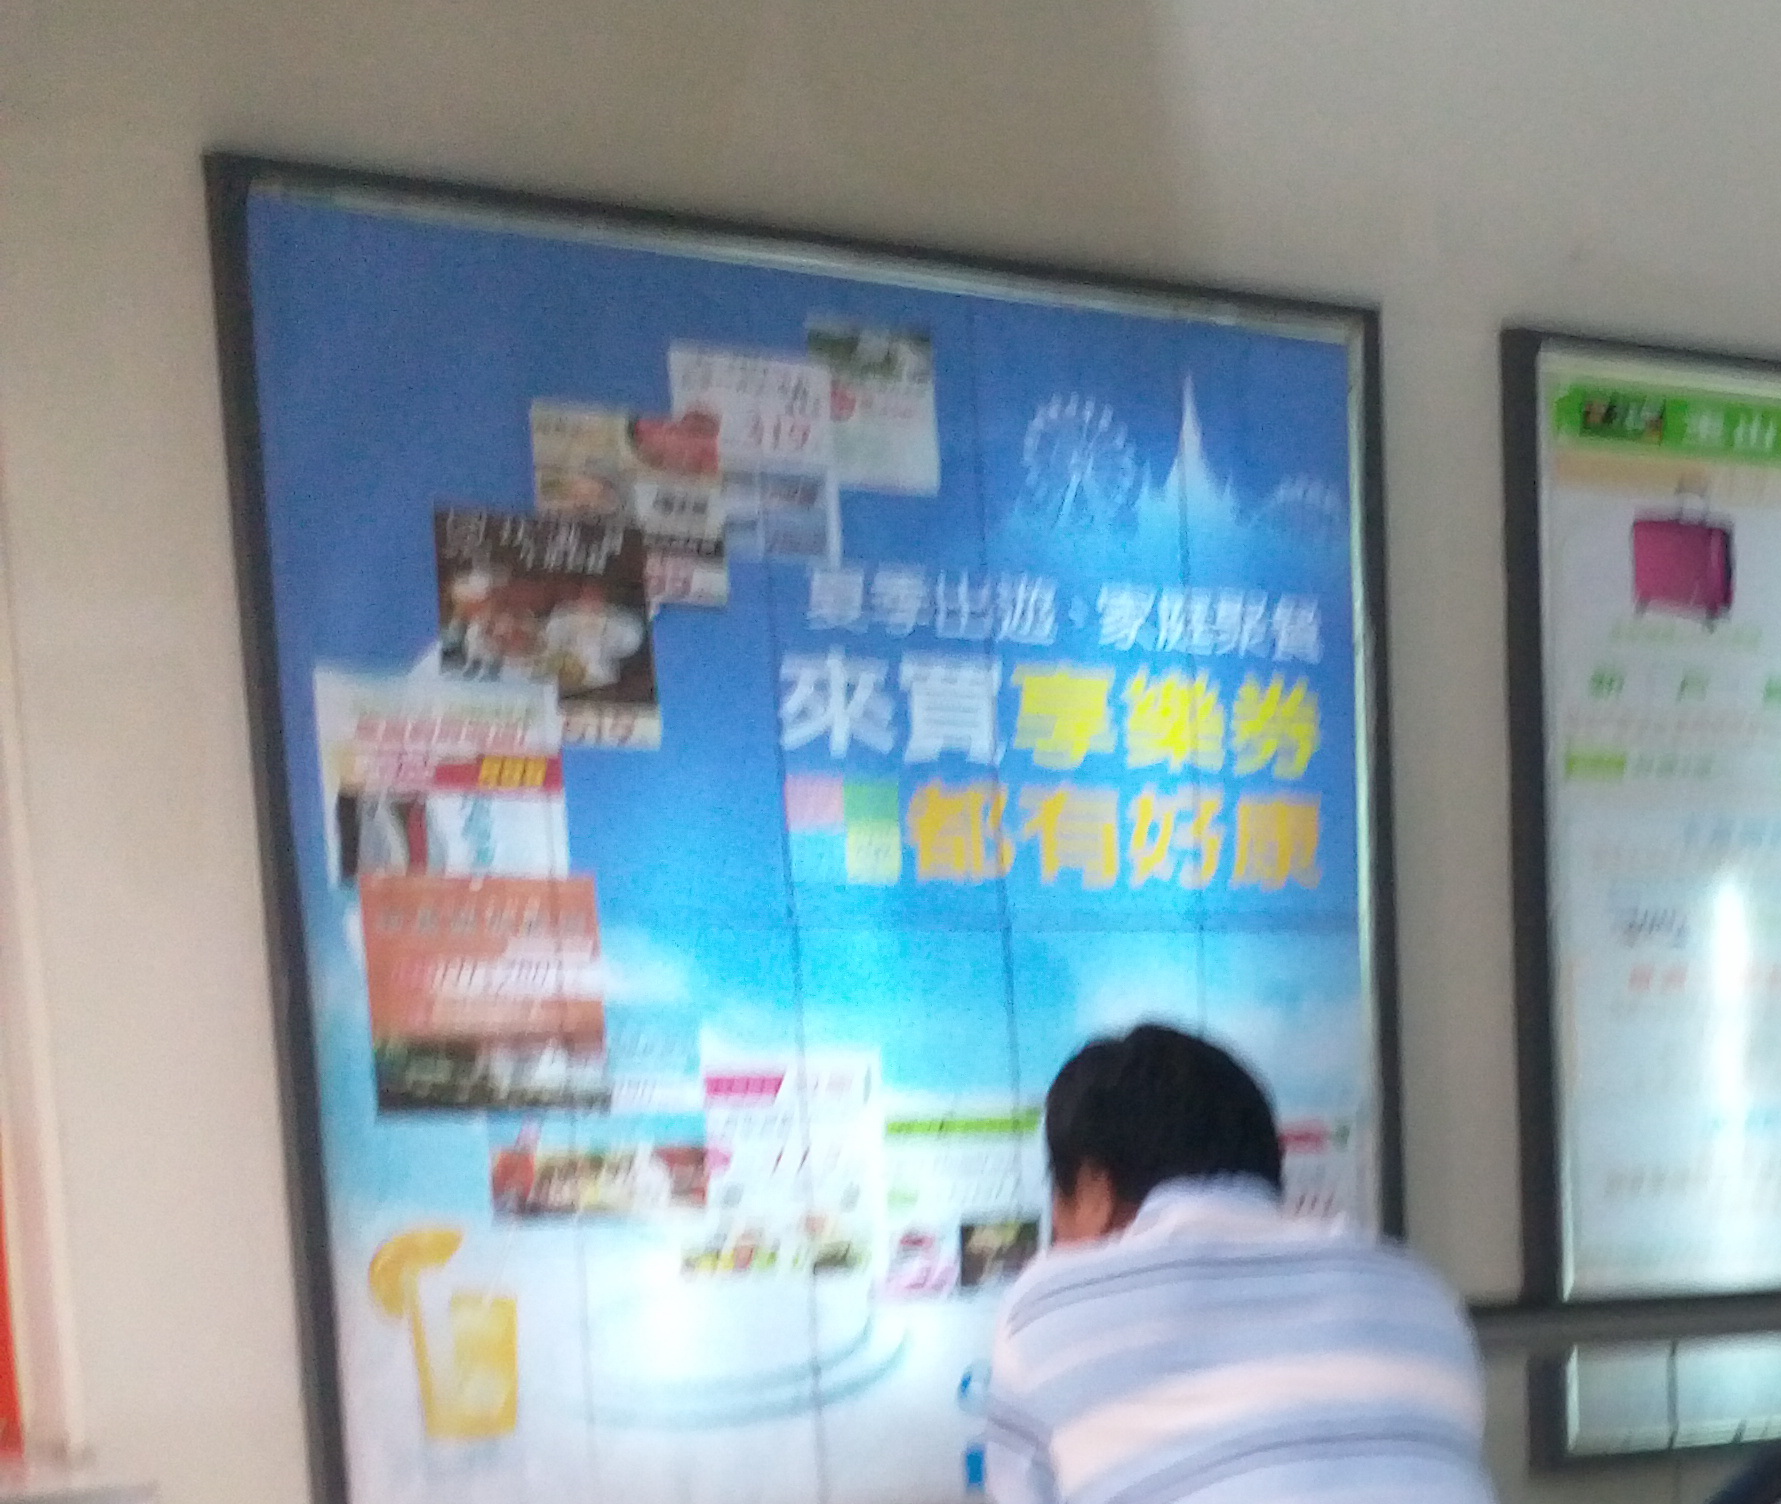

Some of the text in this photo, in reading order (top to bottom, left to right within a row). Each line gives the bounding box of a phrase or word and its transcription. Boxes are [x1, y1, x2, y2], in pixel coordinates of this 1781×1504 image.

[778, 645, 1320, 780] 來買享樂券
[906, 776, 1322, 892] 都有好康
